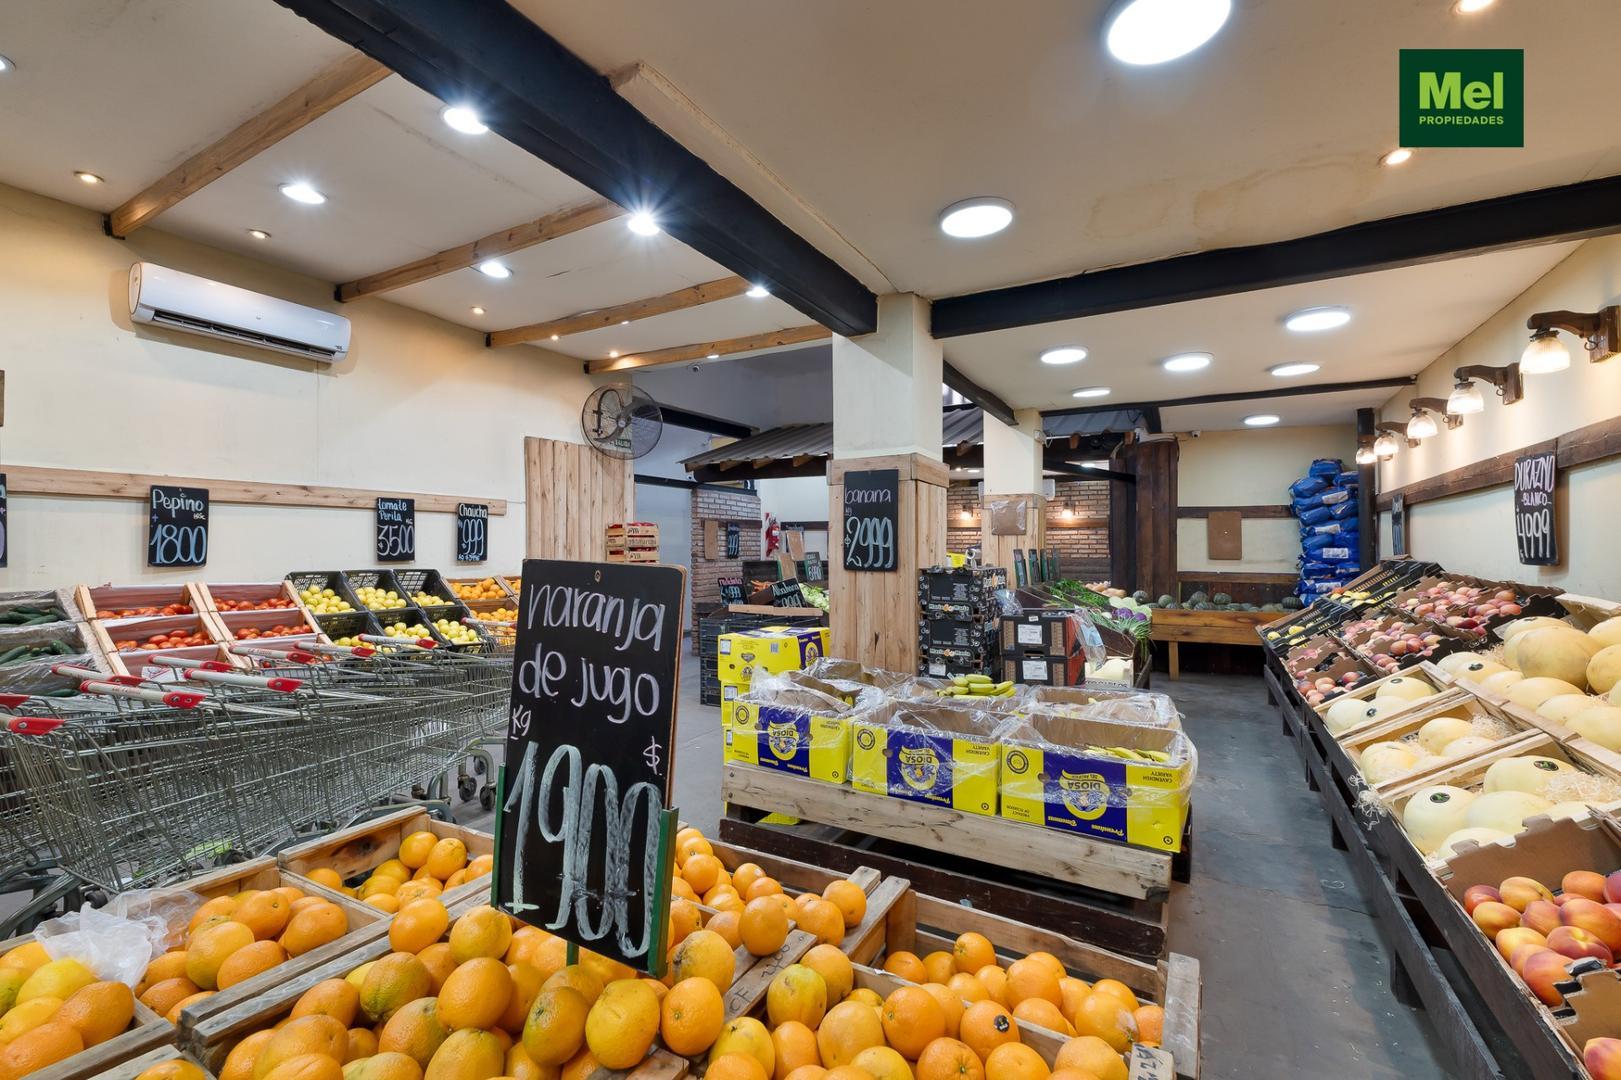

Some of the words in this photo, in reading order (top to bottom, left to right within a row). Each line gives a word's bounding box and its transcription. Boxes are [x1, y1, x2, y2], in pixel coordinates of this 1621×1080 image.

[1514, 456, 1555, 493] DURAZNO
[152, 488, 205, 519] Pepino
[844, 487, 891, 504] banana
[150, 524, 207, 564] 1800
[377, 525, 415, 556] 3500
[846, 516, 895, 569] 2999
[1517, 508, 1550, 559] 4999
[528, 584, 667, 651] naranja
[518, 643, 567, 699] de
[570, 657, 660, 724] jugo
[905, 755, 933, 763] DIOSA
[1067, 781, 1100, 791] DIOSA
[1142, 776, 1173, 784] CAVENDISH
[503, 741, 662, 958] 1900
